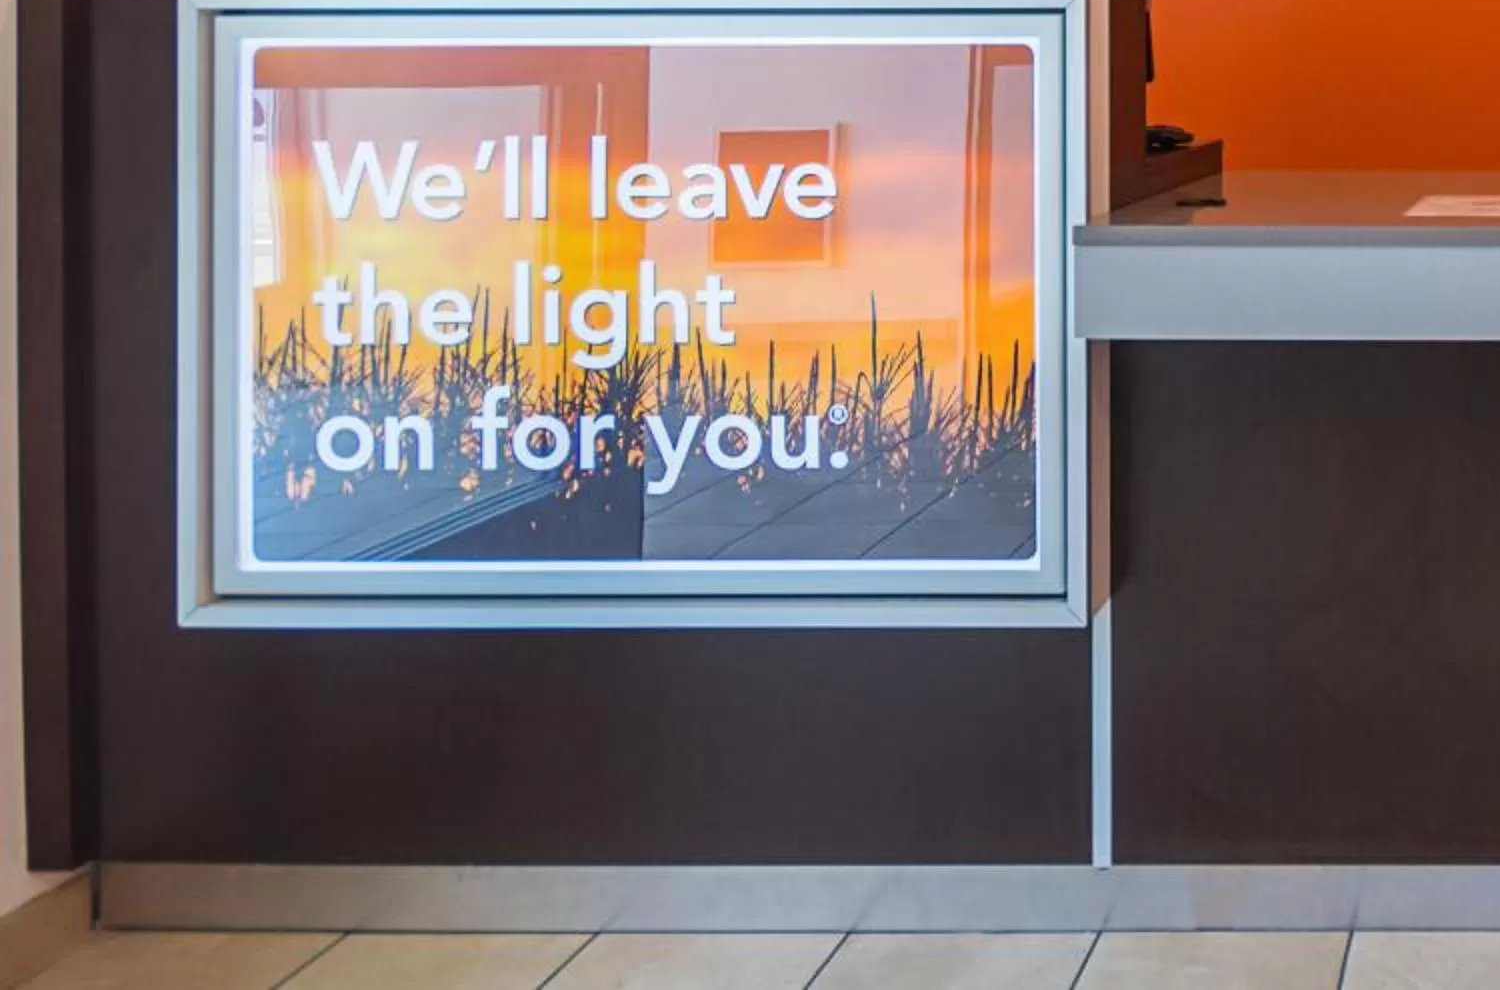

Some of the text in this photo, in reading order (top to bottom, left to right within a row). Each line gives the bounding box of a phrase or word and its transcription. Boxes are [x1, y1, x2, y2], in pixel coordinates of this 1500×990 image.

[313, 134, 837, 220] We’ll leave
[313, 260, 736, 371] the light
[315, 412, 435, 473] on
[472, 385, 614, 471] for
